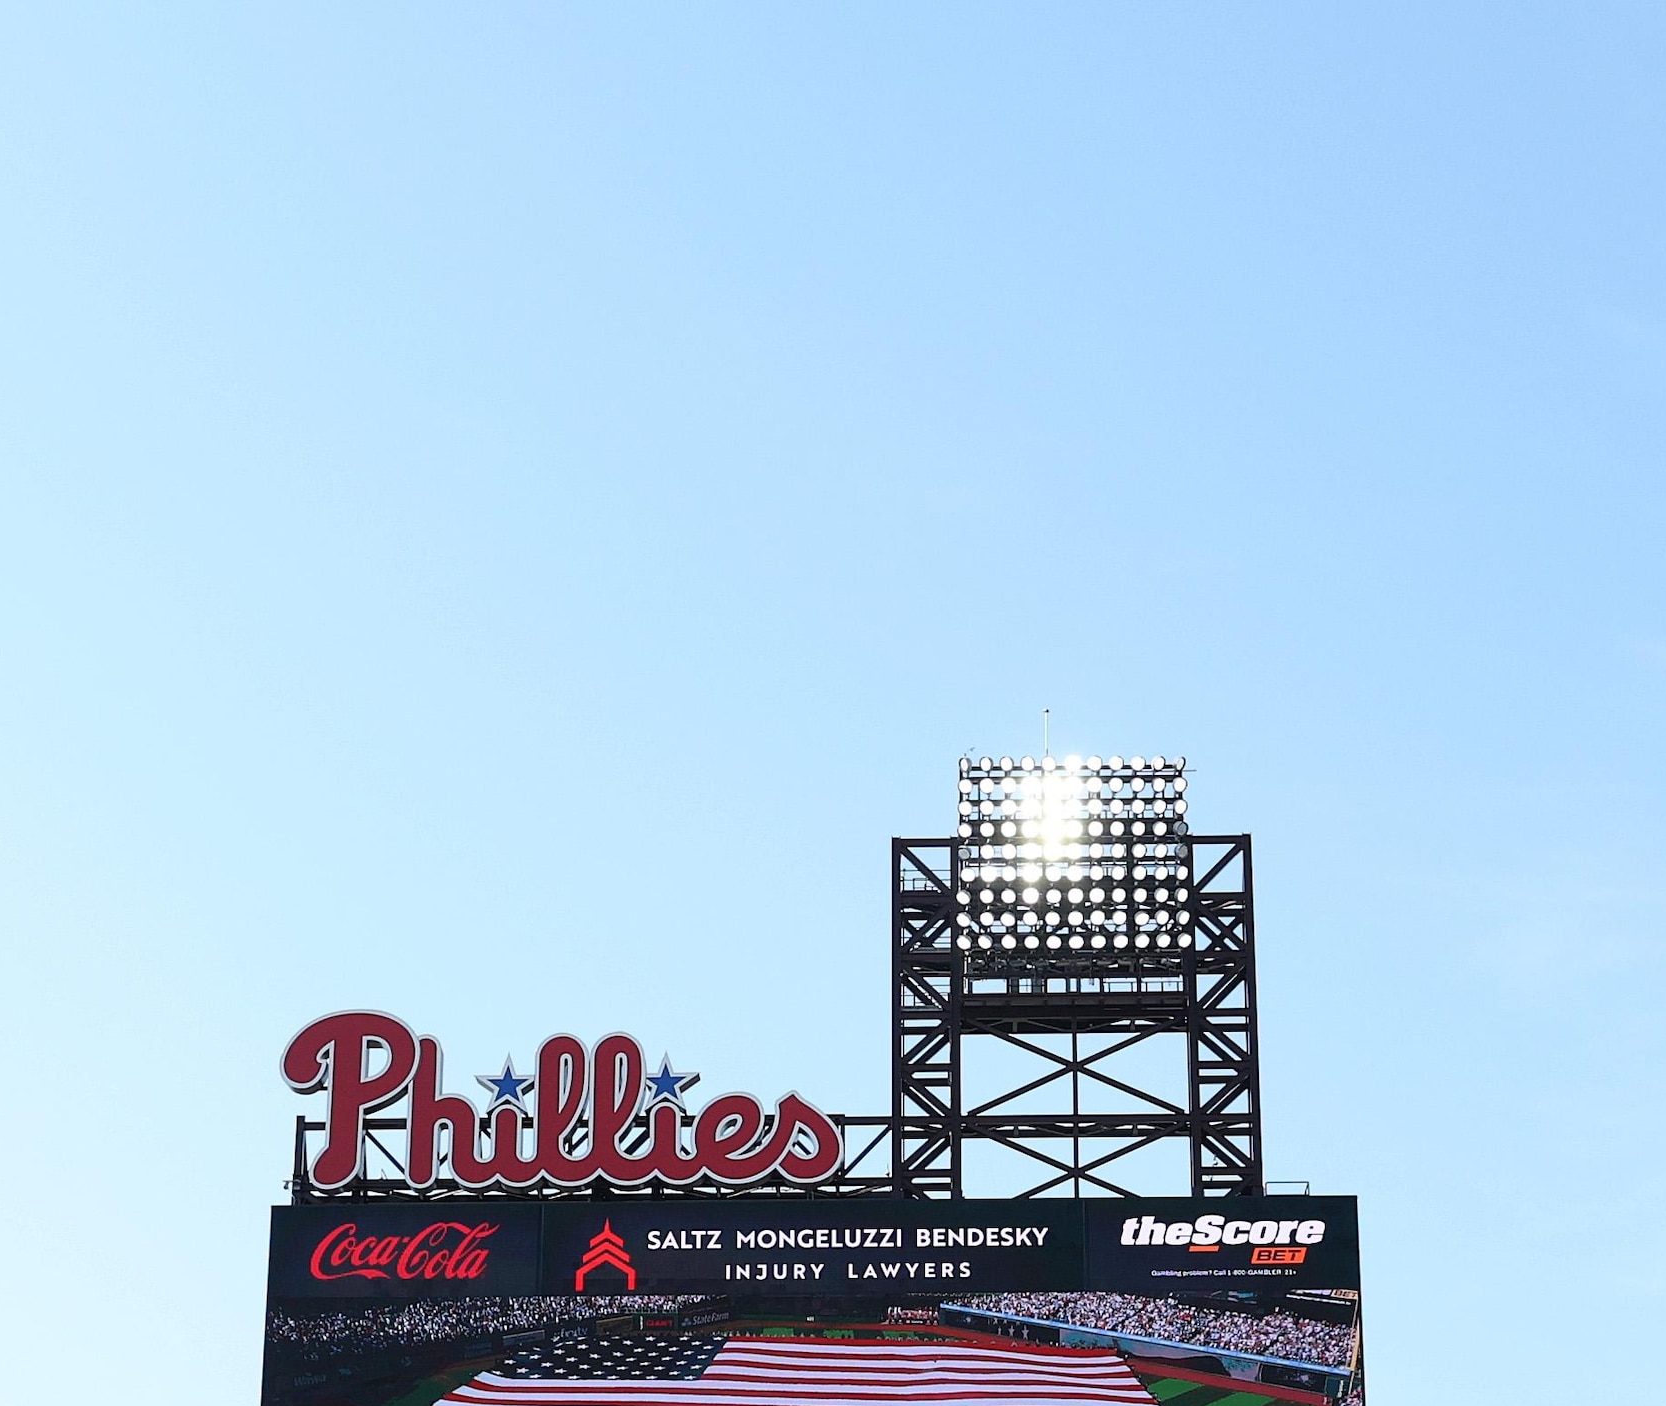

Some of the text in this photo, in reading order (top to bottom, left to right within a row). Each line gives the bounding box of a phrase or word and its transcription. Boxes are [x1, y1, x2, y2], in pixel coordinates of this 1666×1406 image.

[281, 1009, 844, 1189] Phillies
[647, 1227, 1049, 1250] SALTZ MONGELUZZI BENDESKY
[1121, 1214, 1326, 1246] theScore
[309, 1222, 501, 1281] Coca-Cola
[1255, 1249, 1304, 1263] BET
[724, 1262, 971, 1280] INJURY LAWYERS
